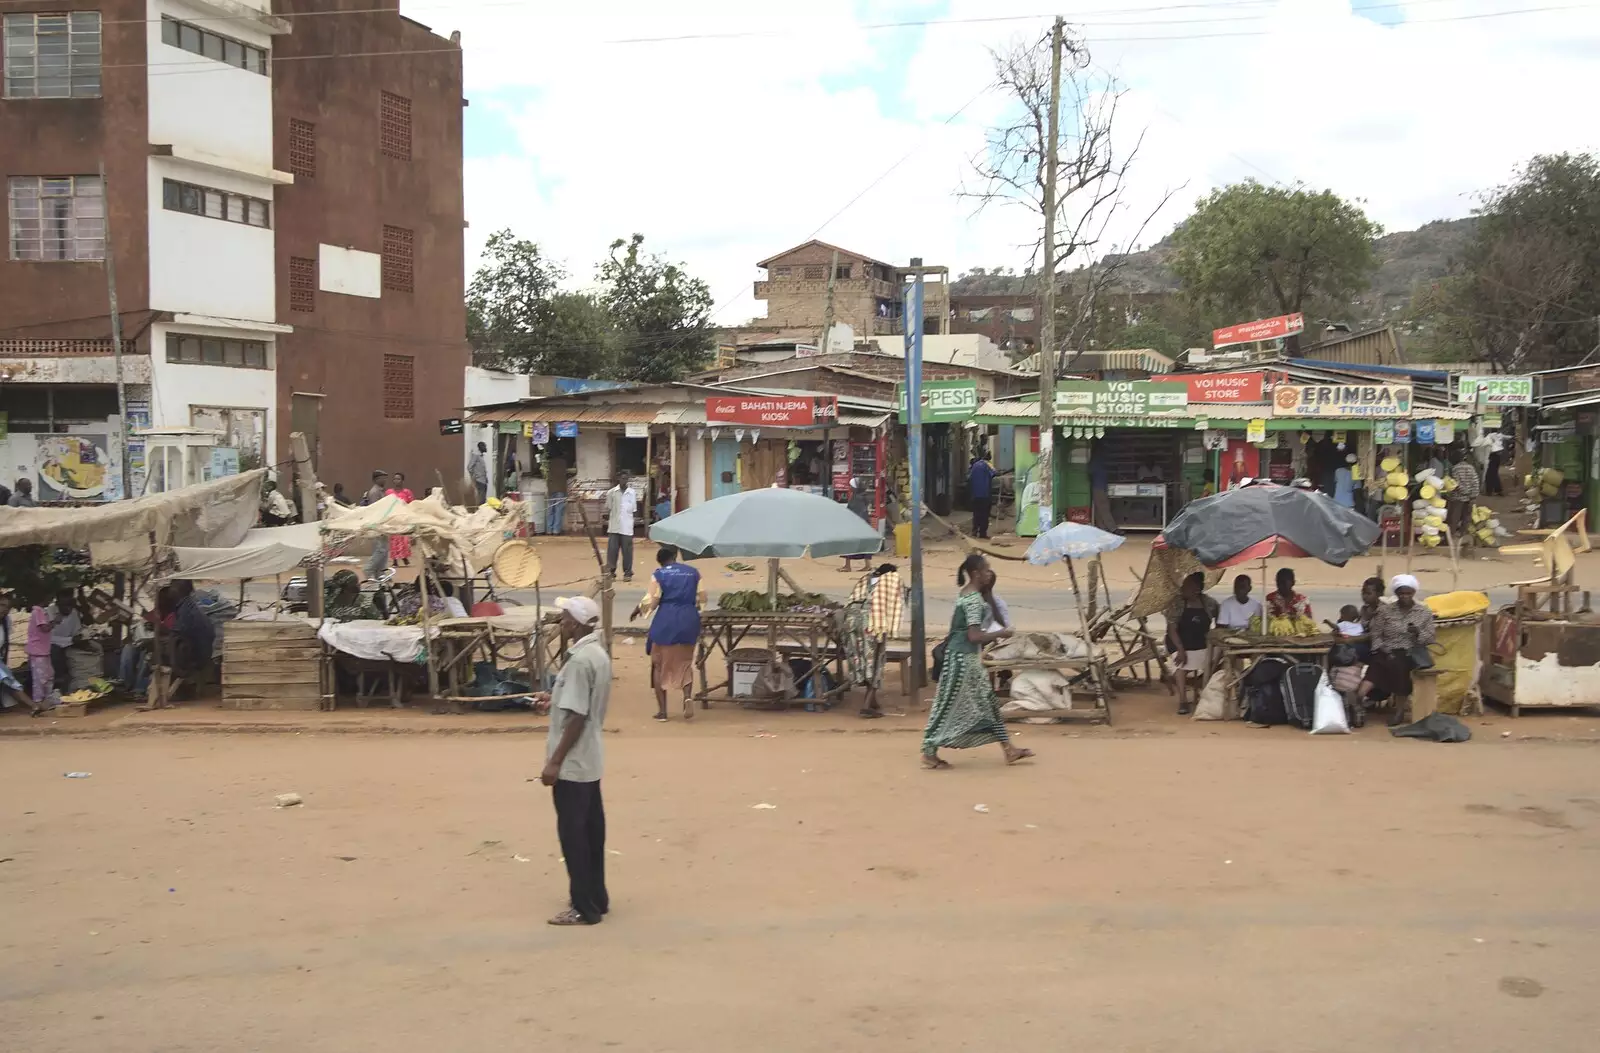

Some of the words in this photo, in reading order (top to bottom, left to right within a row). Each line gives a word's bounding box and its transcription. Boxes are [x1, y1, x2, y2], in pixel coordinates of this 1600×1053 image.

[1108, 382, 1133, 392] VOI
[1194, 379, 1214, 388] VOI
[1216, 378, 1249, 387] MUSIC
[1095, 393, 1147, 403] MUSIC
[1205, 389, 1240, 399] STORE
[1301, 386, 1392, 405] ERIMBA
[741, 401, 775, 410] BAHATI
[776, 401, 808, 410] NJEMA
[1095, 403, 1146, 414] STORE
[761, 412, 790, 421] KIOSK
